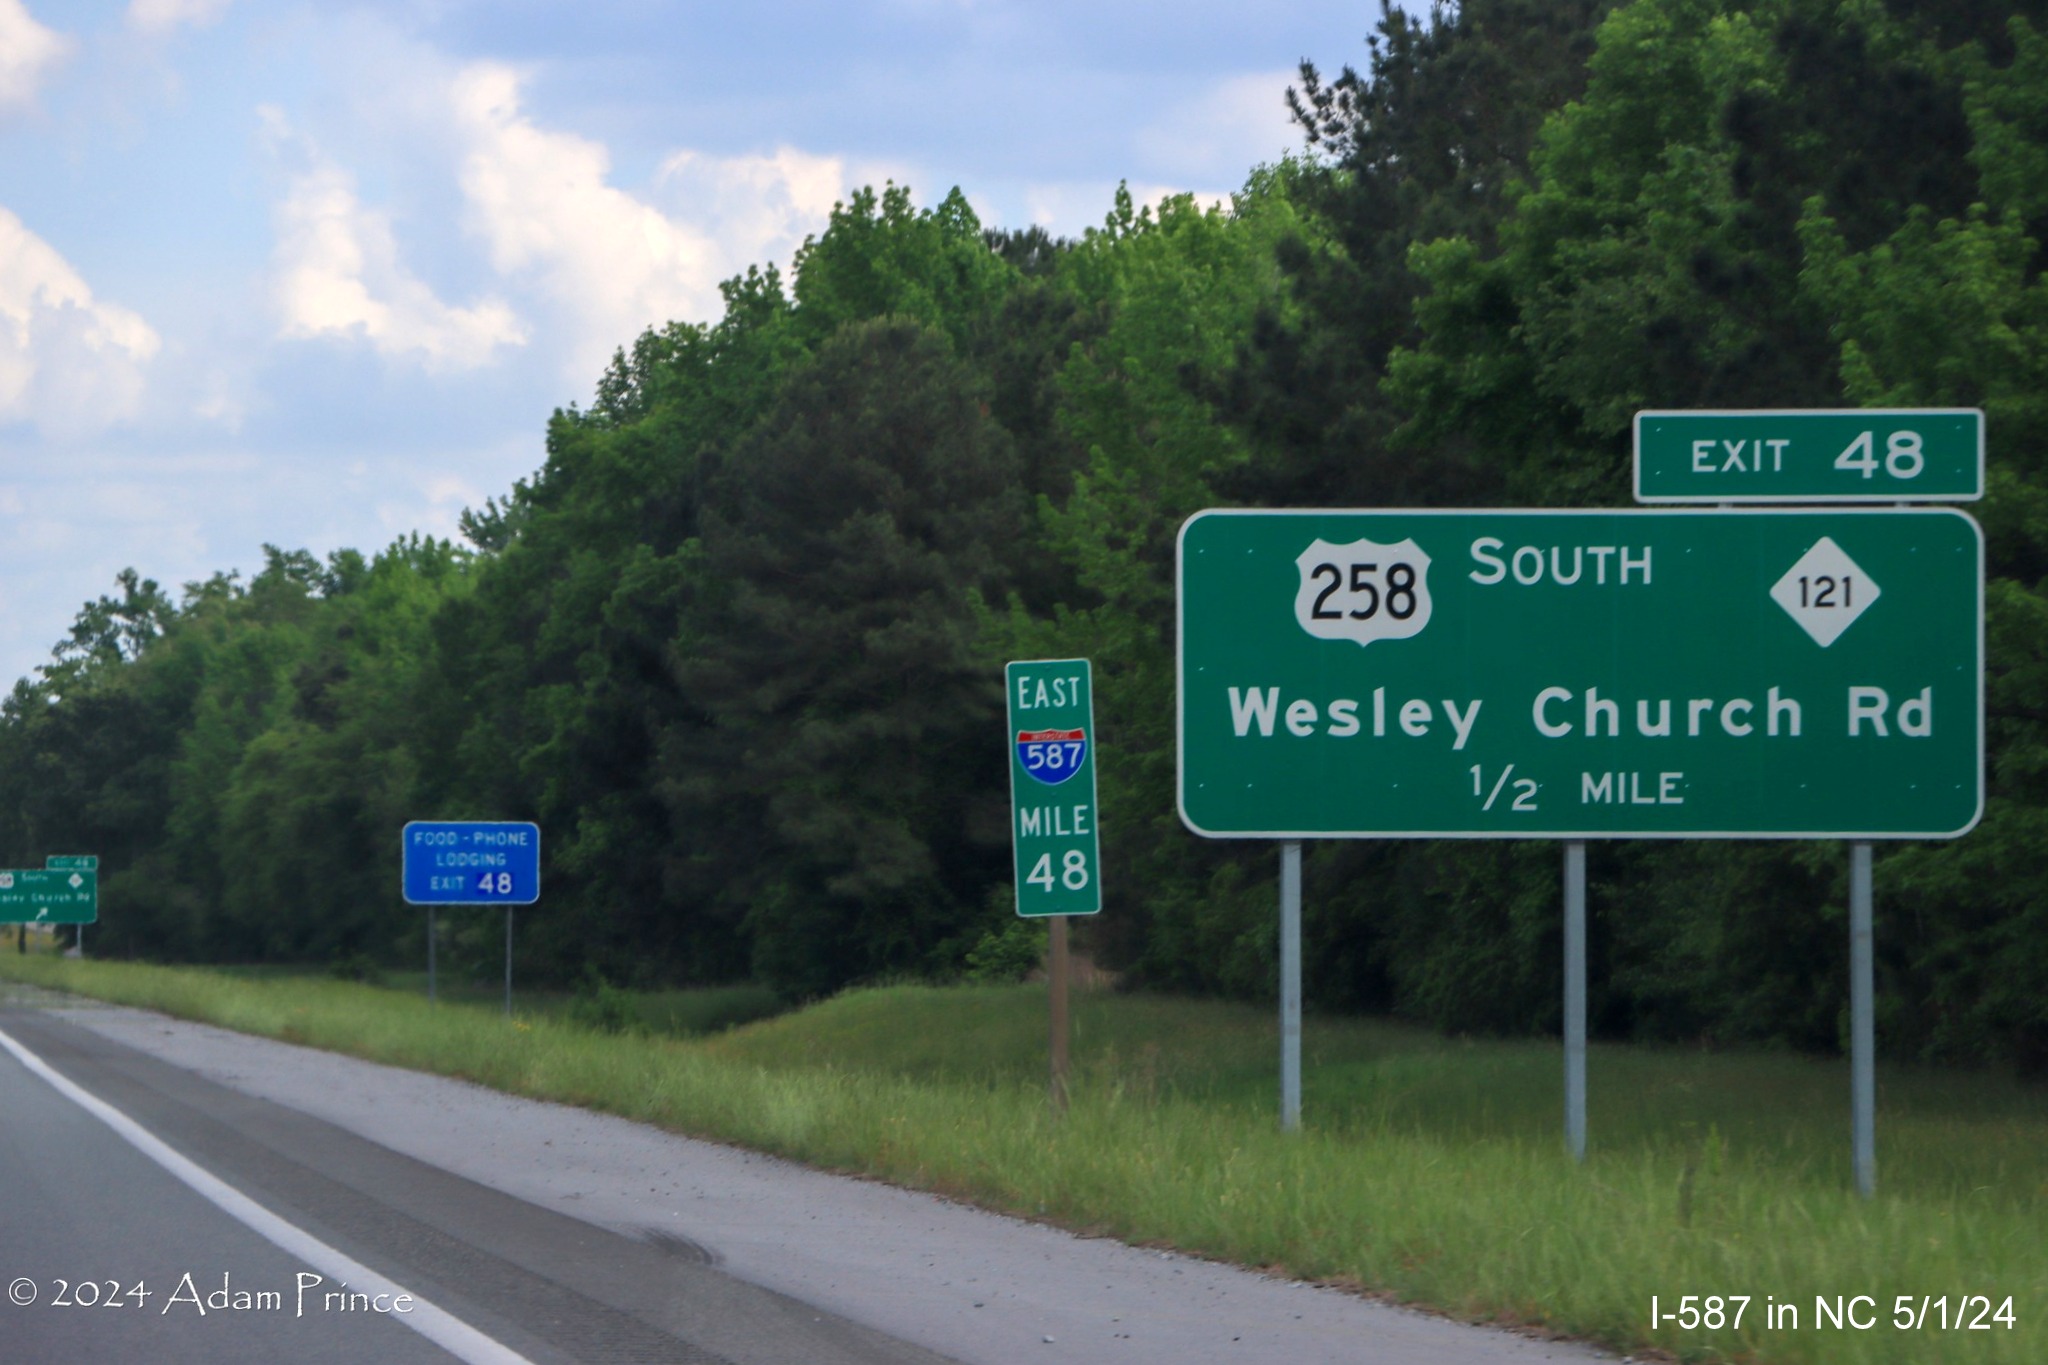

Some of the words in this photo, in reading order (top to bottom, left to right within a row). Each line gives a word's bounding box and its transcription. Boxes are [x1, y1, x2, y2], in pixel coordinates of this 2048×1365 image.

[1692, 438, 1790, 473] EXIT
[1834, 429, 1925, 479] 48
[1468, 536, 1652, 586] SOUTH
[1311, 562, 1417, 621] 258
[1799, 575, 1852, 608] 121
[1018, 676, 1080, 710] EAST
[1227, 686, 1483, 750] Wesley
[1532, 686, 1801, 738] Church
[1848, 685, 1933, 738] Rd
[1027, 743, 1082, 770] 587
[1469, 763, 1539, 811] 1/2
[1581, 771, 1685, 804] MILE
[1020, 804, 1090, 838] MILE
[414, 831, 457, 846] FOOD
[473, 831, 528, 846] PHONE
[436, 852, 507, 867] LODGING
[1026, 849, 1089, 893] 48
[430, 875, 465, 891] EXIT
[478, 872, 512, 894] 48
